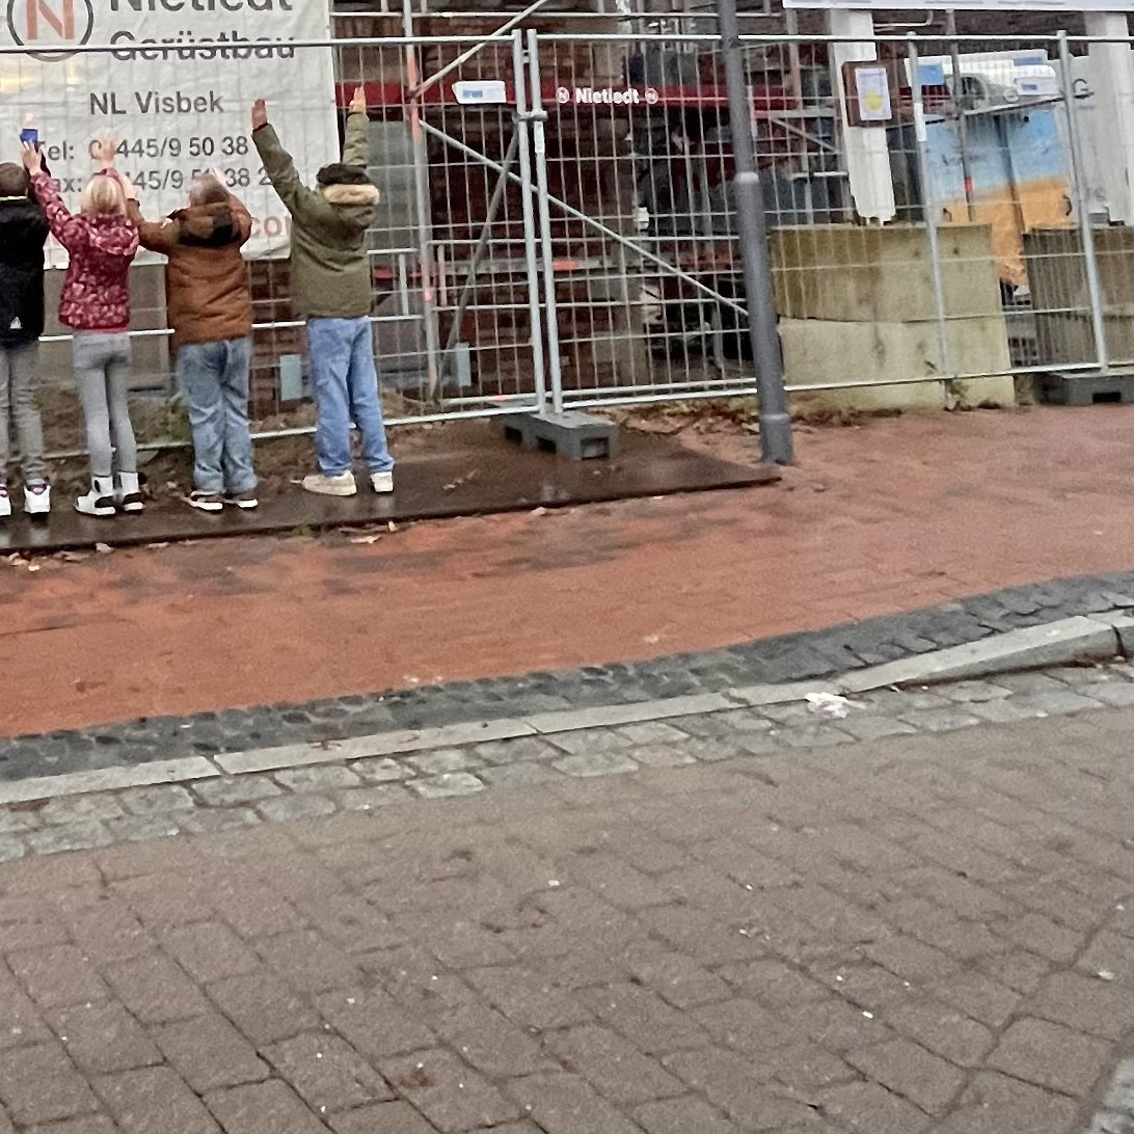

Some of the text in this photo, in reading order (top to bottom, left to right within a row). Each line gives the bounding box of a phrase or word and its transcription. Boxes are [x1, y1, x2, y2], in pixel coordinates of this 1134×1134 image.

[109, 29, 296, 61] Gerüstbau
[89, 90, 225, 115] NL Visbek
[575, 87, 639, 104] Nietiedt
[89, 137, 182, 159] 0445/9
[189, 137, 215, 157] 50
[221, 136, 249, 156] 38
[224, 168, 251, 187] 38
